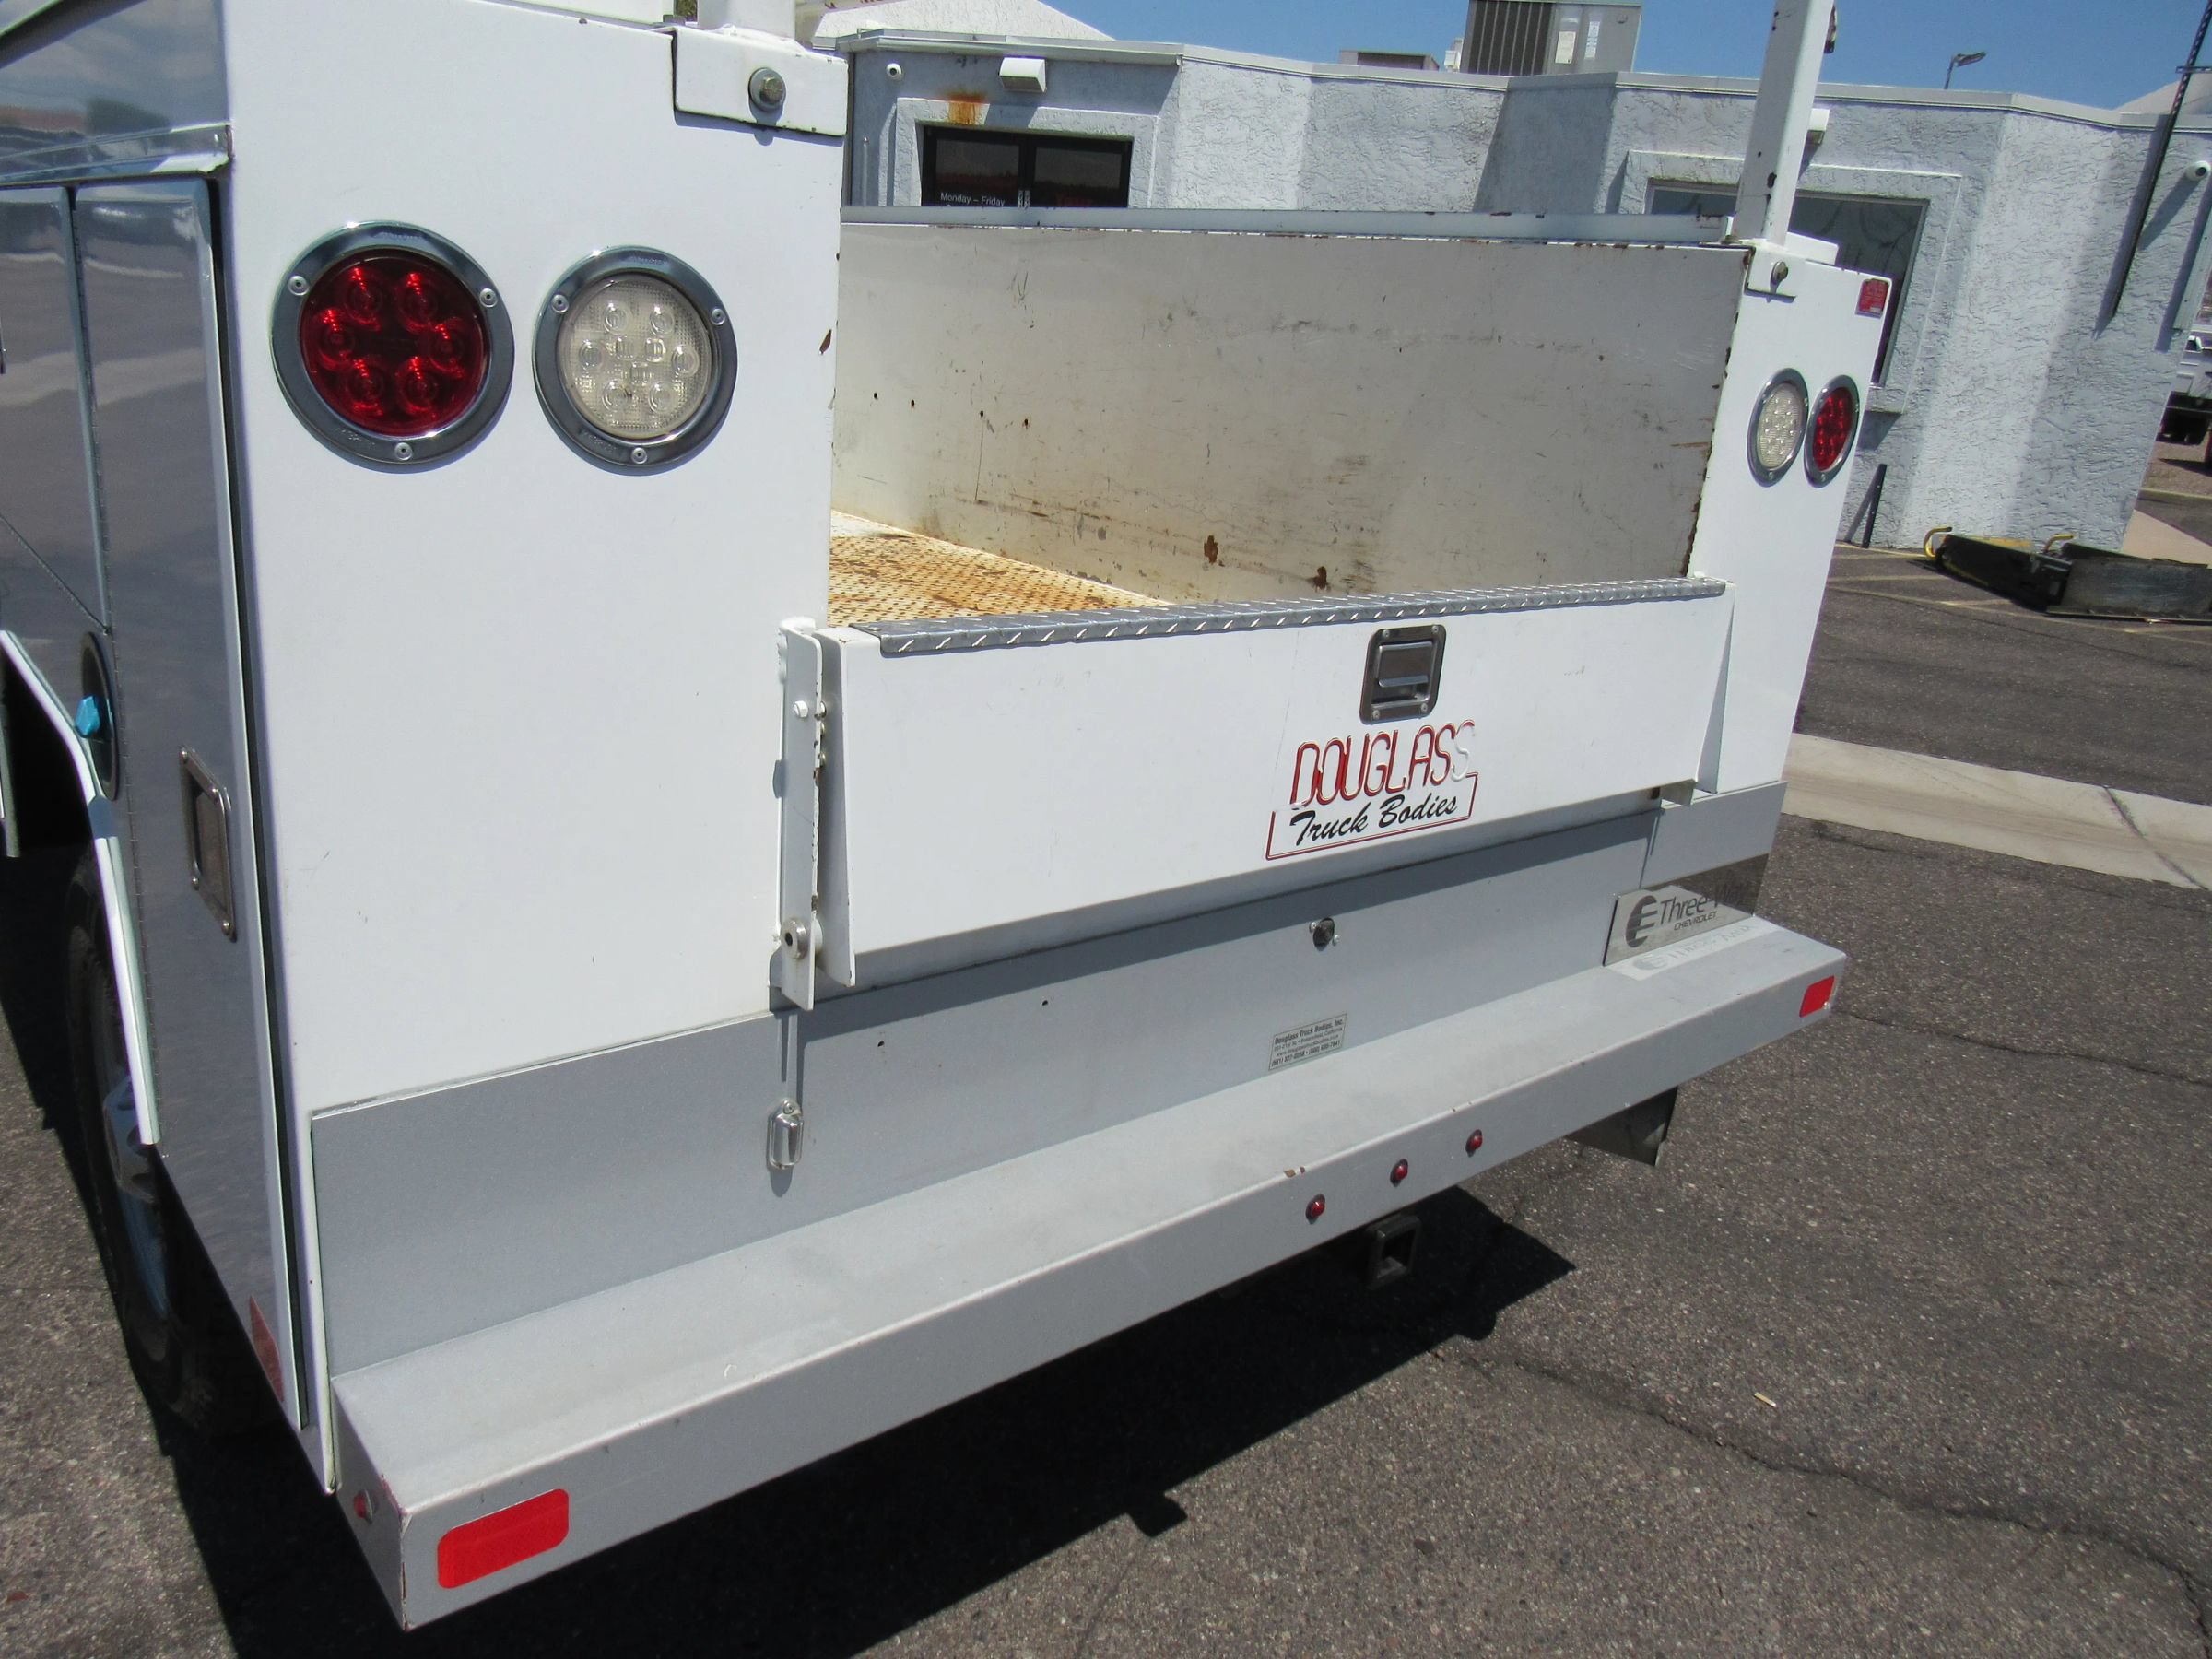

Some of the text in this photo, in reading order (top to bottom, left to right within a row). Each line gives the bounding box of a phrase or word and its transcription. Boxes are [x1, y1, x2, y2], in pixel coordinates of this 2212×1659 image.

[940, 192, 971, 204] Monday
[981, 195, 1006, 206] Friday
[1289, 719, 1476, 810] DOUGLASS
[1289, 793, 1458, 847] Truck Bodies
[1674, 911, 1718, 931] CHEVROLET
[1300, 1027, 1313, 1037] Truck
